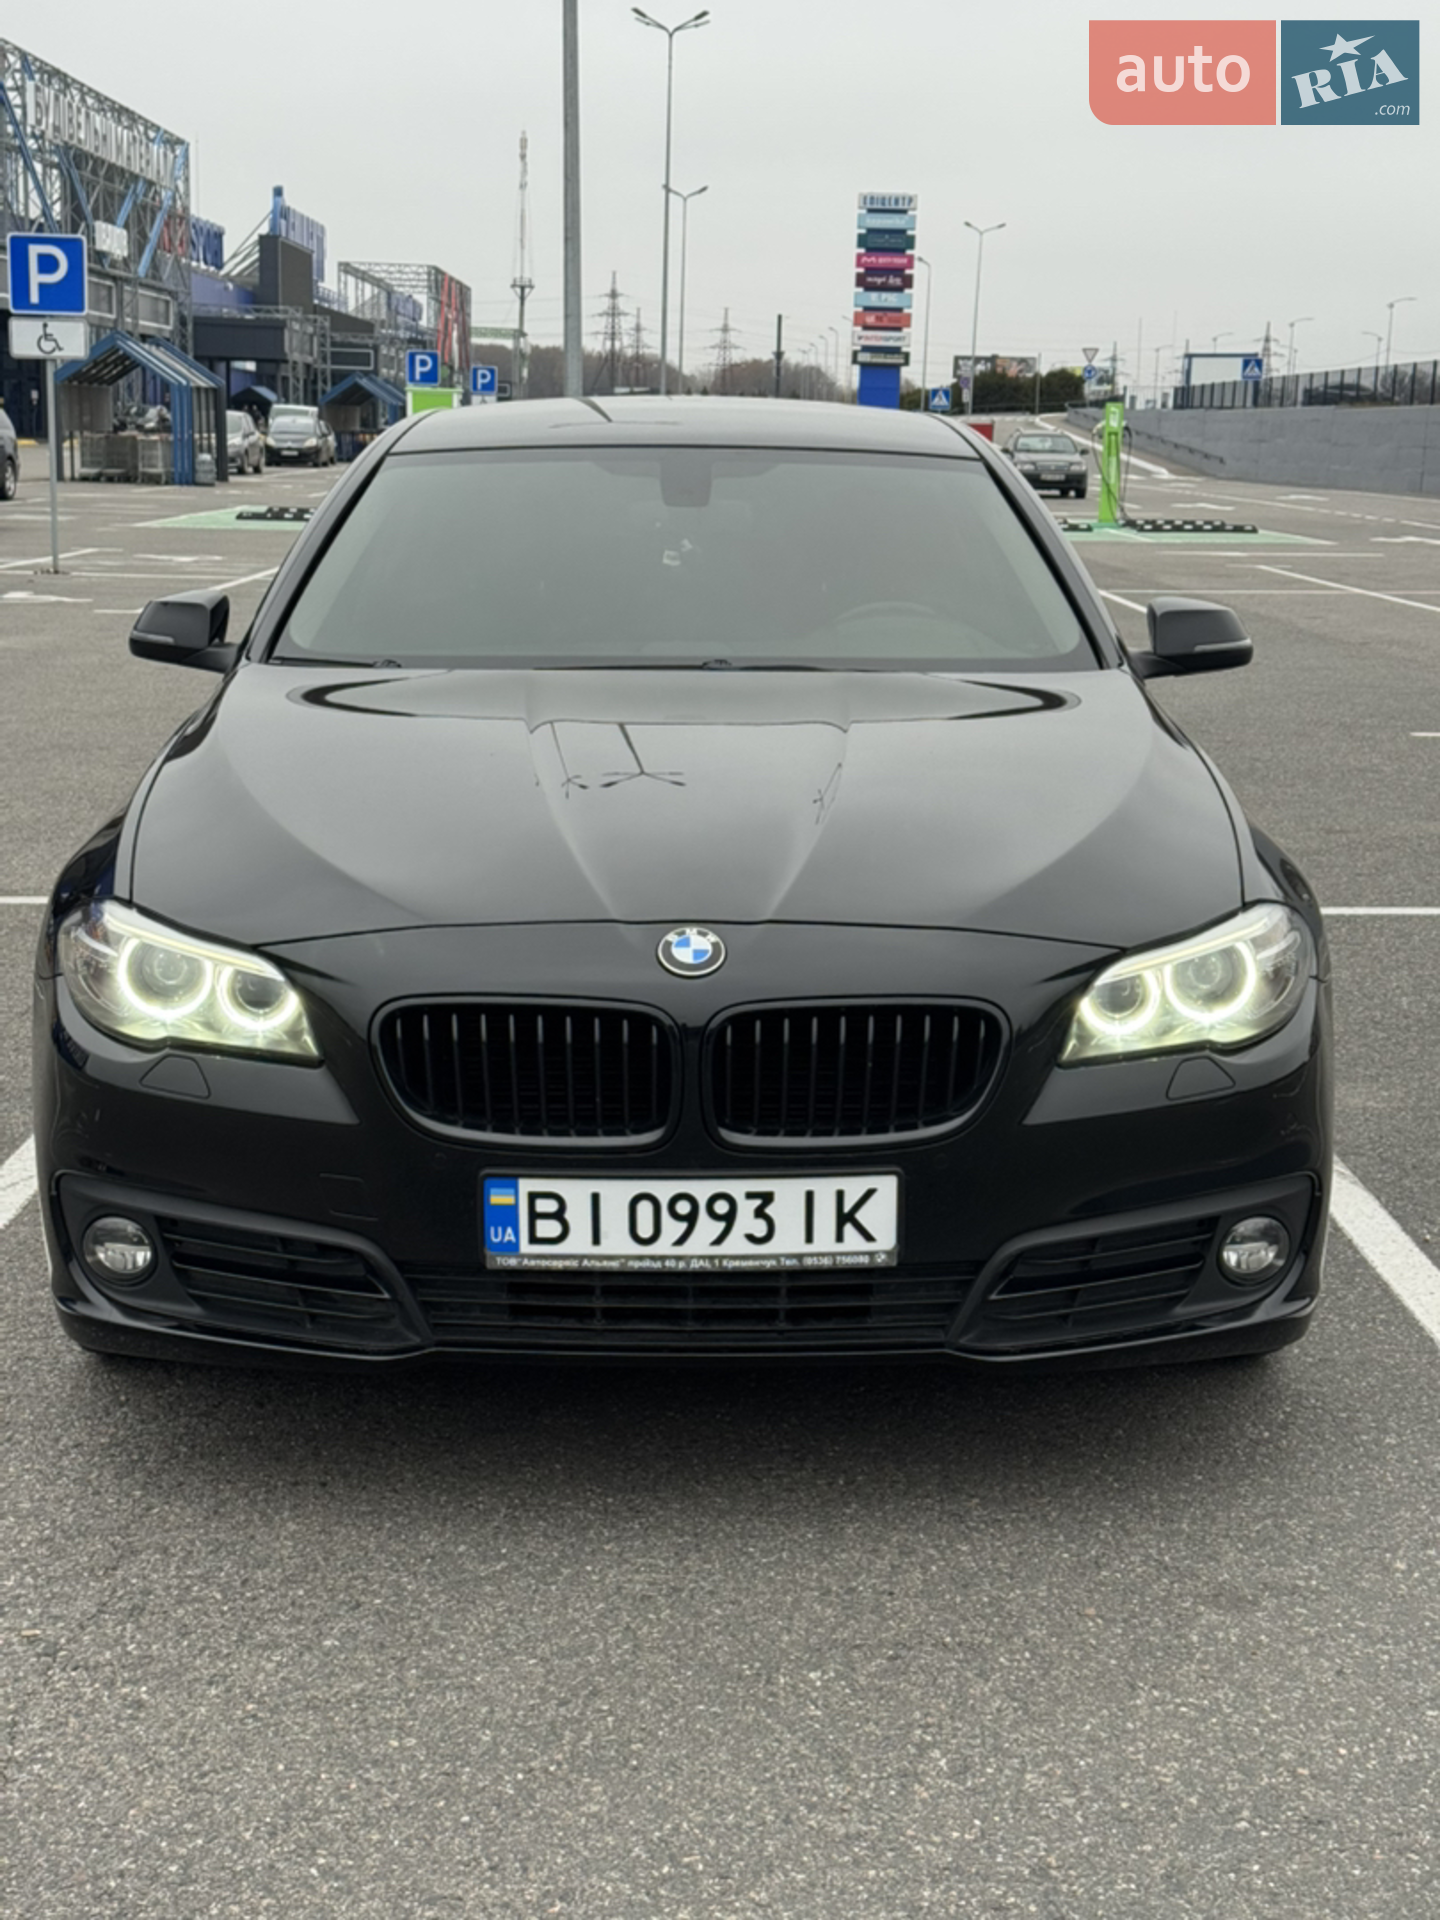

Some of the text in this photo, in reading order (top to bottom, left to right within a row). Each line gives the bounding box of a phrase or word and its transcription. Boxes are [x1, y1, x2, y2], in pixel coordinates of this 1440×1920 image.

[27, 245, 68, 305] P
[415, 355, 433, 381] P
[477, 369, 491, 390] P
[527, 1188, 878, 1246] BI 0993 IK
[490, 1226, 516, 1243] UA
